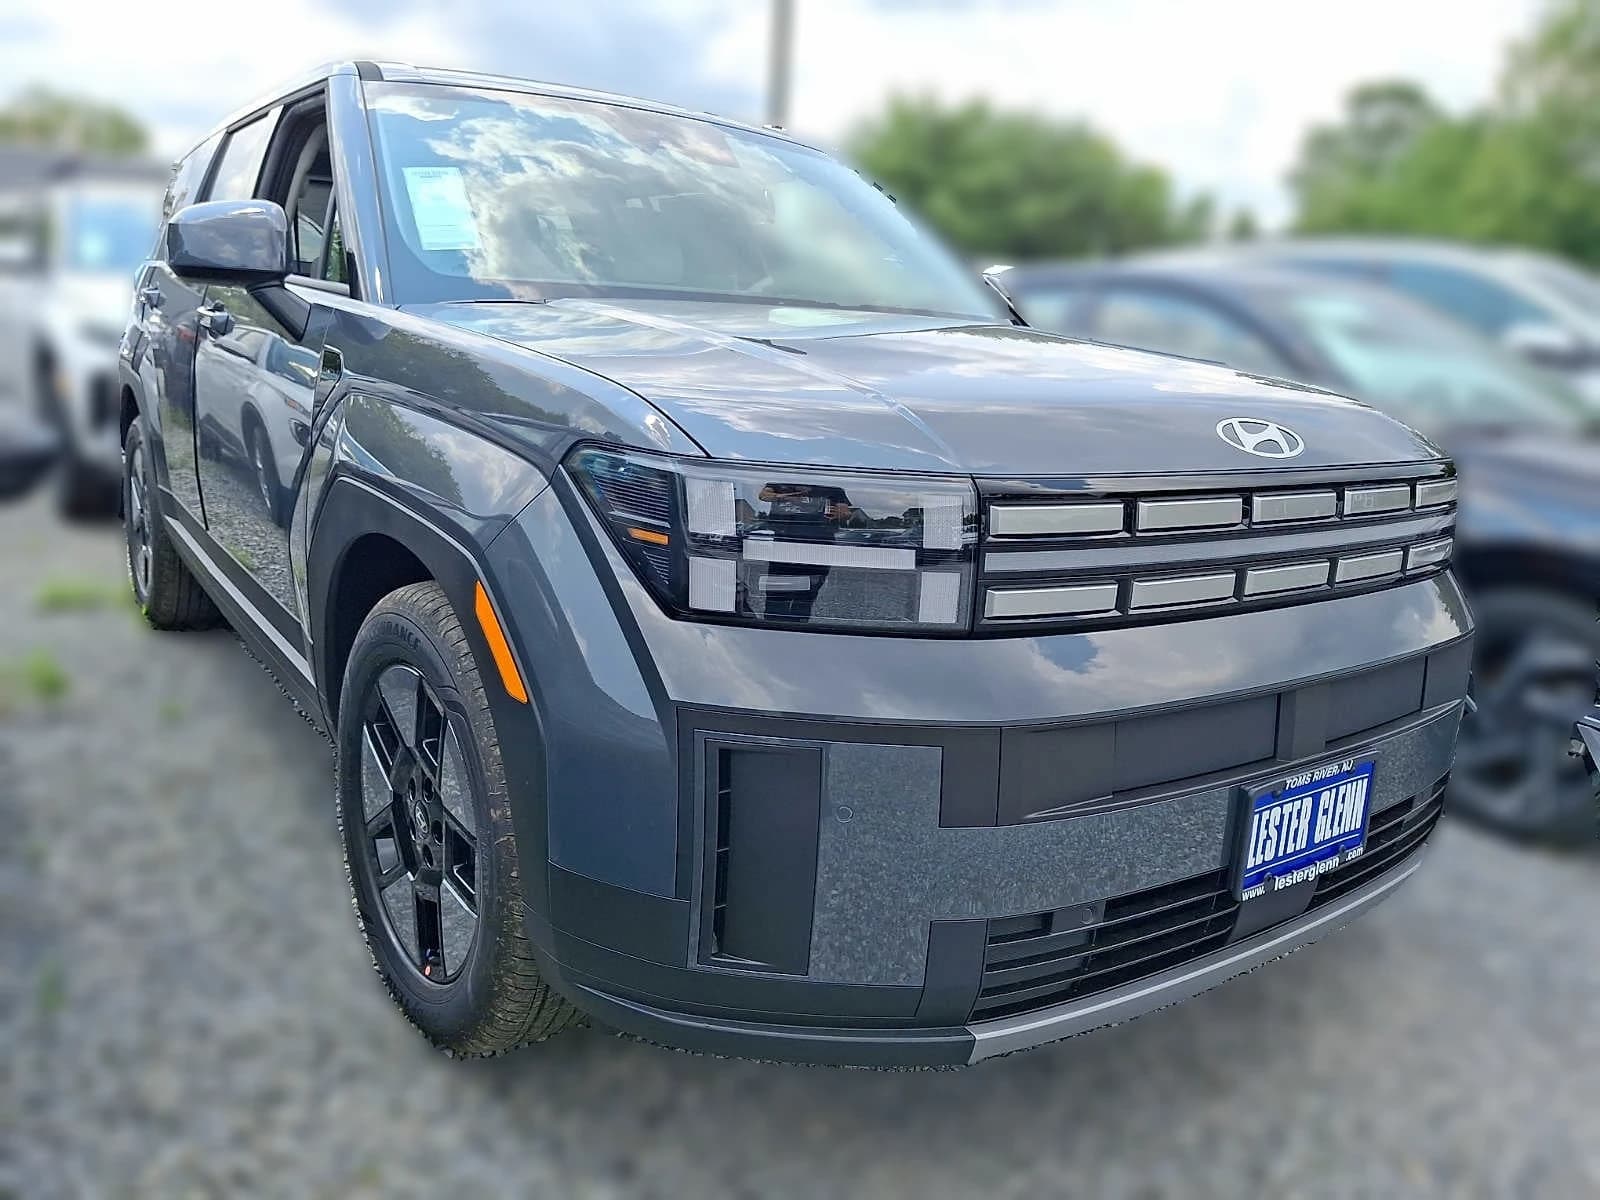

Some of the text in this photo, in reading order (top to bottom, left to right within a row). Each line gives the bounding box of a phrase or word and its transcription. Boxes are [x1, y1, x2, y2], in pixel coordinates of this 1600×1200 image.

[1285, 759, 1354, 791] TOMS RIVER, NJ
[1246, 778, 1369, 869] LESTER GLENN
[1241, 885, 1266, 902] www.
[1273, 856, 1340, 891] lesterglenn
